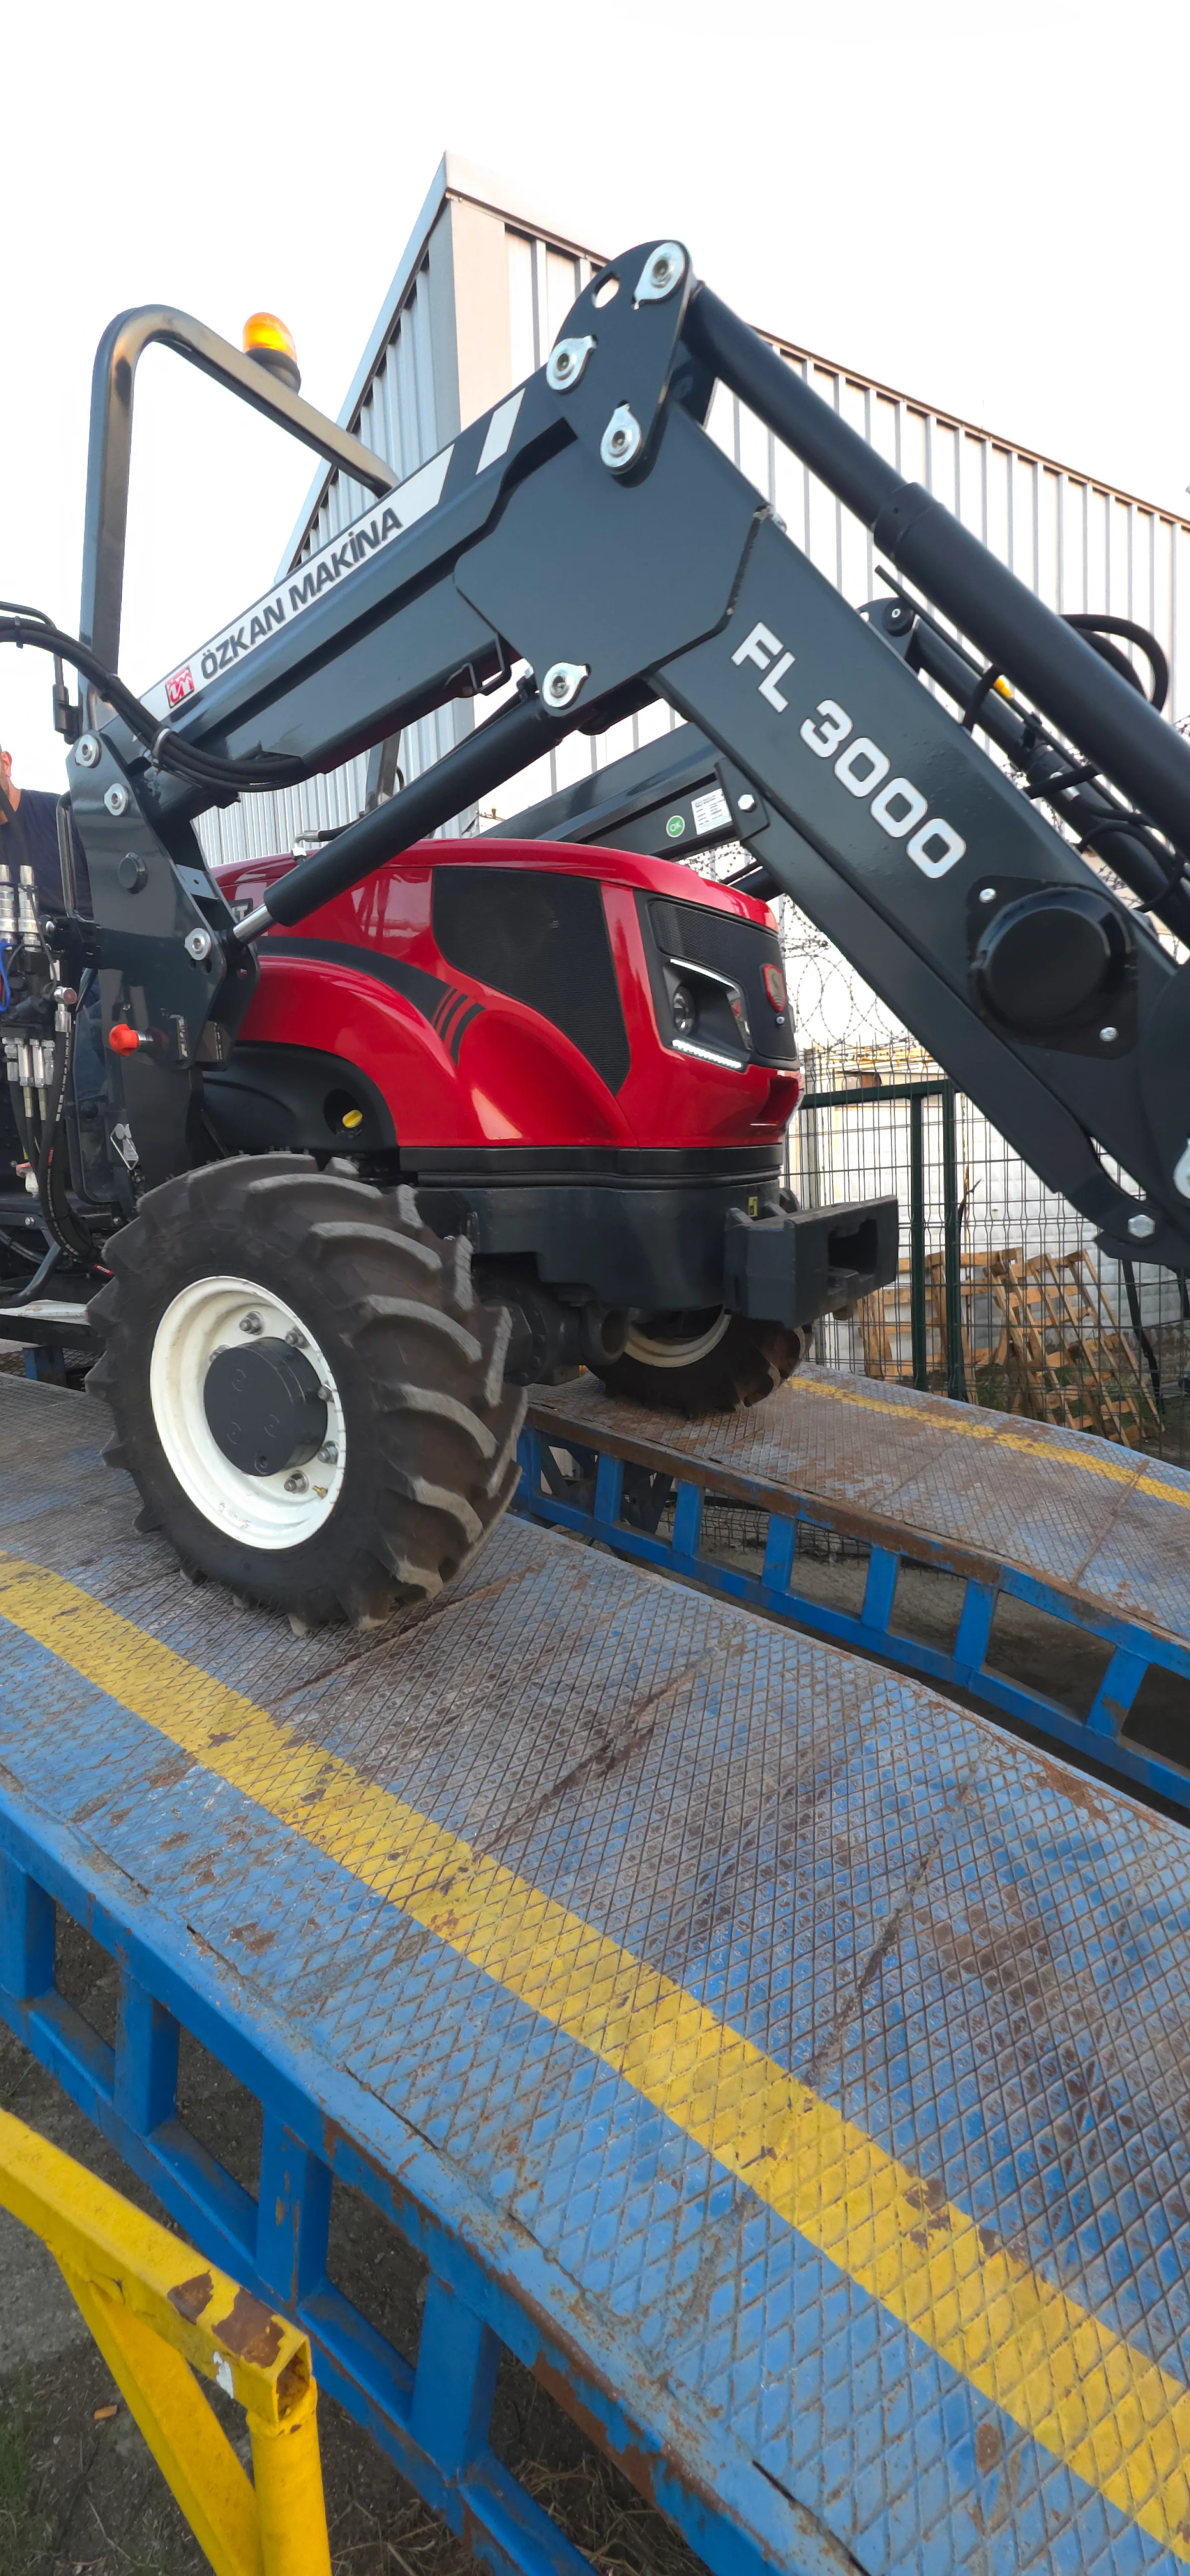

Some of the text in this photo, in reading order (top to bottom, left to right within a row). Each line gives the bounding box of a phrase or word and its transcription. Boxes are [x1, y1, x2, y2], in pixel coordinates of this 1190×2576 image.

[200, 597, 286, 680] ÖZKAN
[289, 508, 403, 612] MAKİNA
[669, 820, 683, 832] OK
[731, 622, 966, 878] FL 3000
